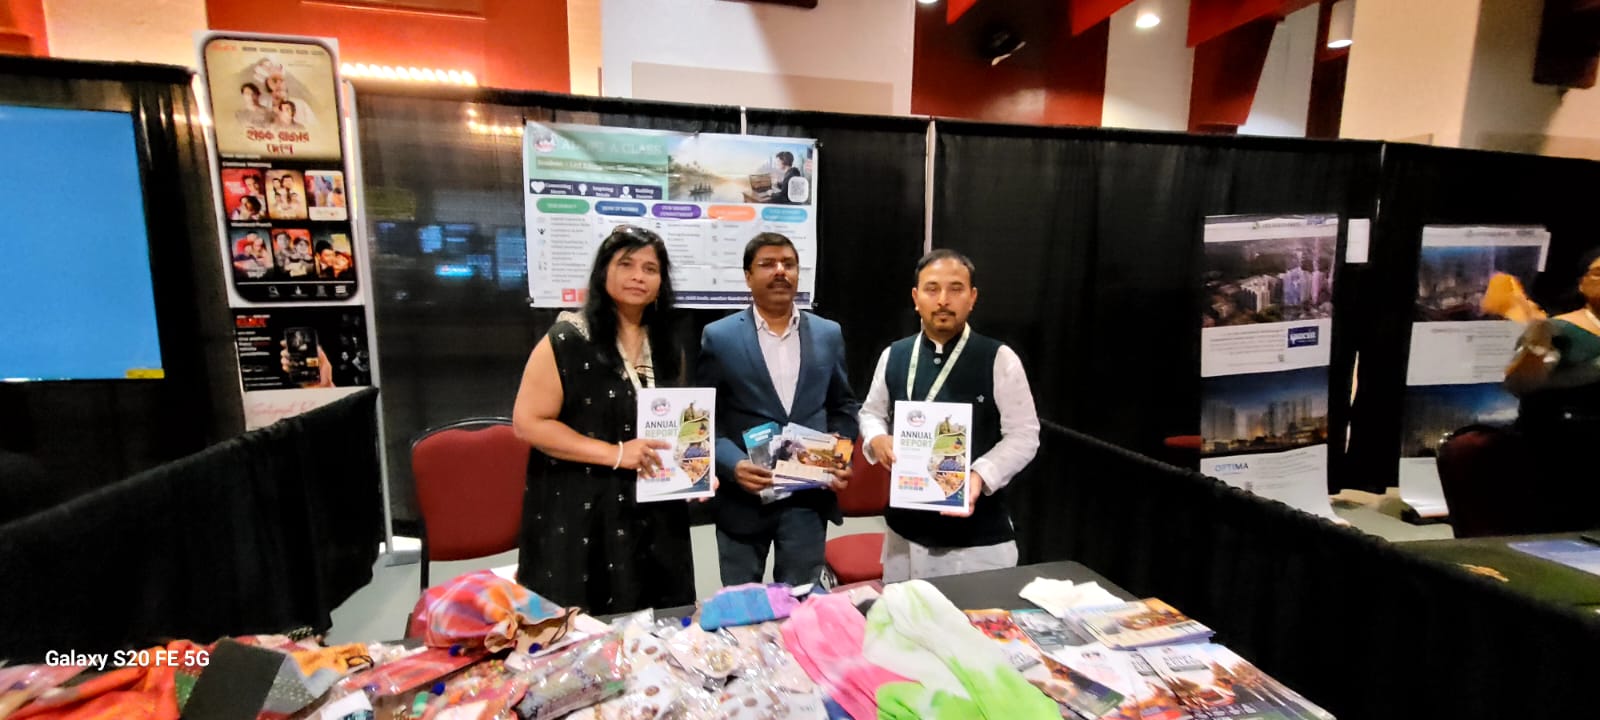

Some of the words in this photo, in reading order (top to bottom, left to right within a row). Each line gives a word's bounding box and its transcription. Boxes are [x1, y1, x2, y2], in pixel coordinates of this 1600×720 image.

[645, 420, 678, 429] ANNUAL
[645, 428, 678, 437] REPORT
[900, 430, 933, 440] ANNUAL
[900, 439, 932, 448] REPORT
[1214, 462, 1249, 472] OPTIMA
